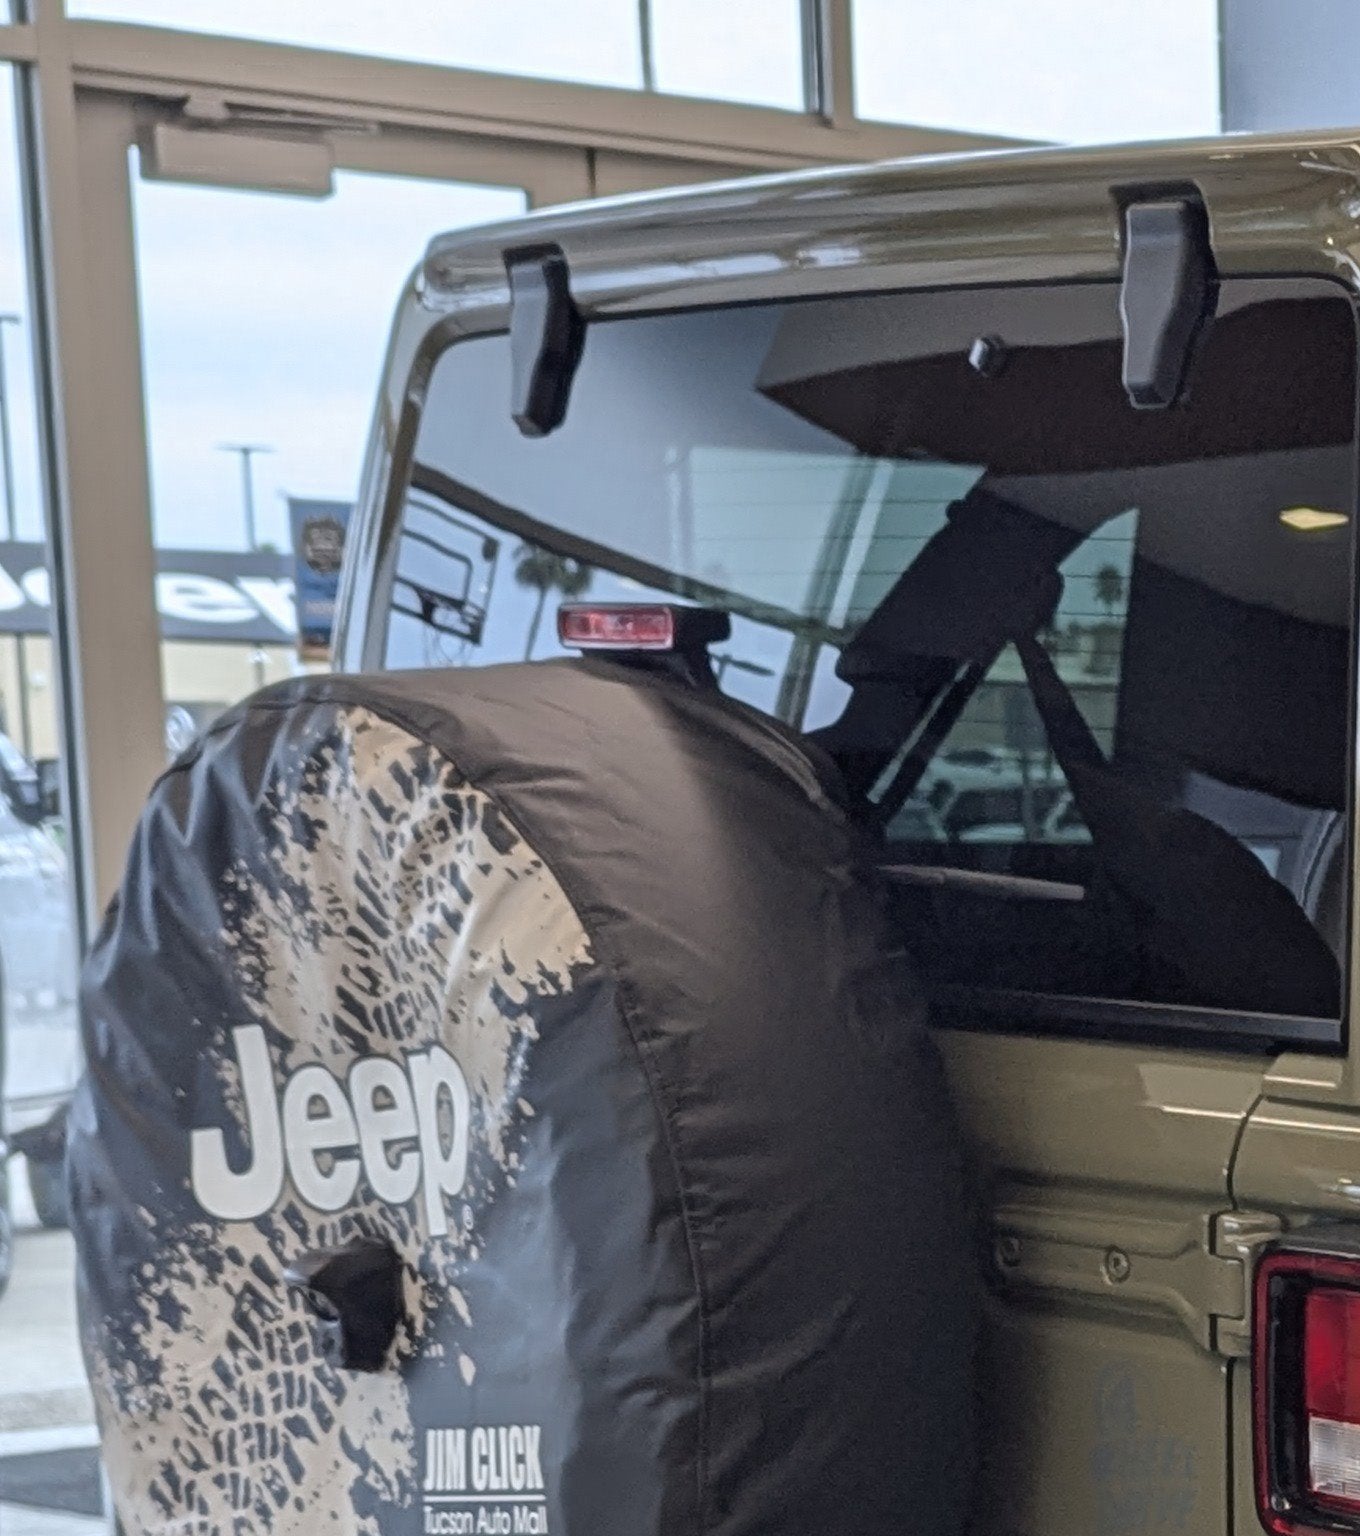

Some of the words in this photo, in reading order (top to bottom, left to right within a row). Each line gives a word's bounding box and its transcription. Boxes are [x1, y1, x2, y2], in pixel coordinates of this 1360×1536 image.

[191, 1023, 470, 1237] Jeep
[424, 1428, 467, 1491] JIM
[471, 1425, 545, 1491] CLICK
[423, 1506, 474, 1534] Tucson
[476, 1505, 512, 1534] Auto
[513, 1505, 548, 1534] Mall
